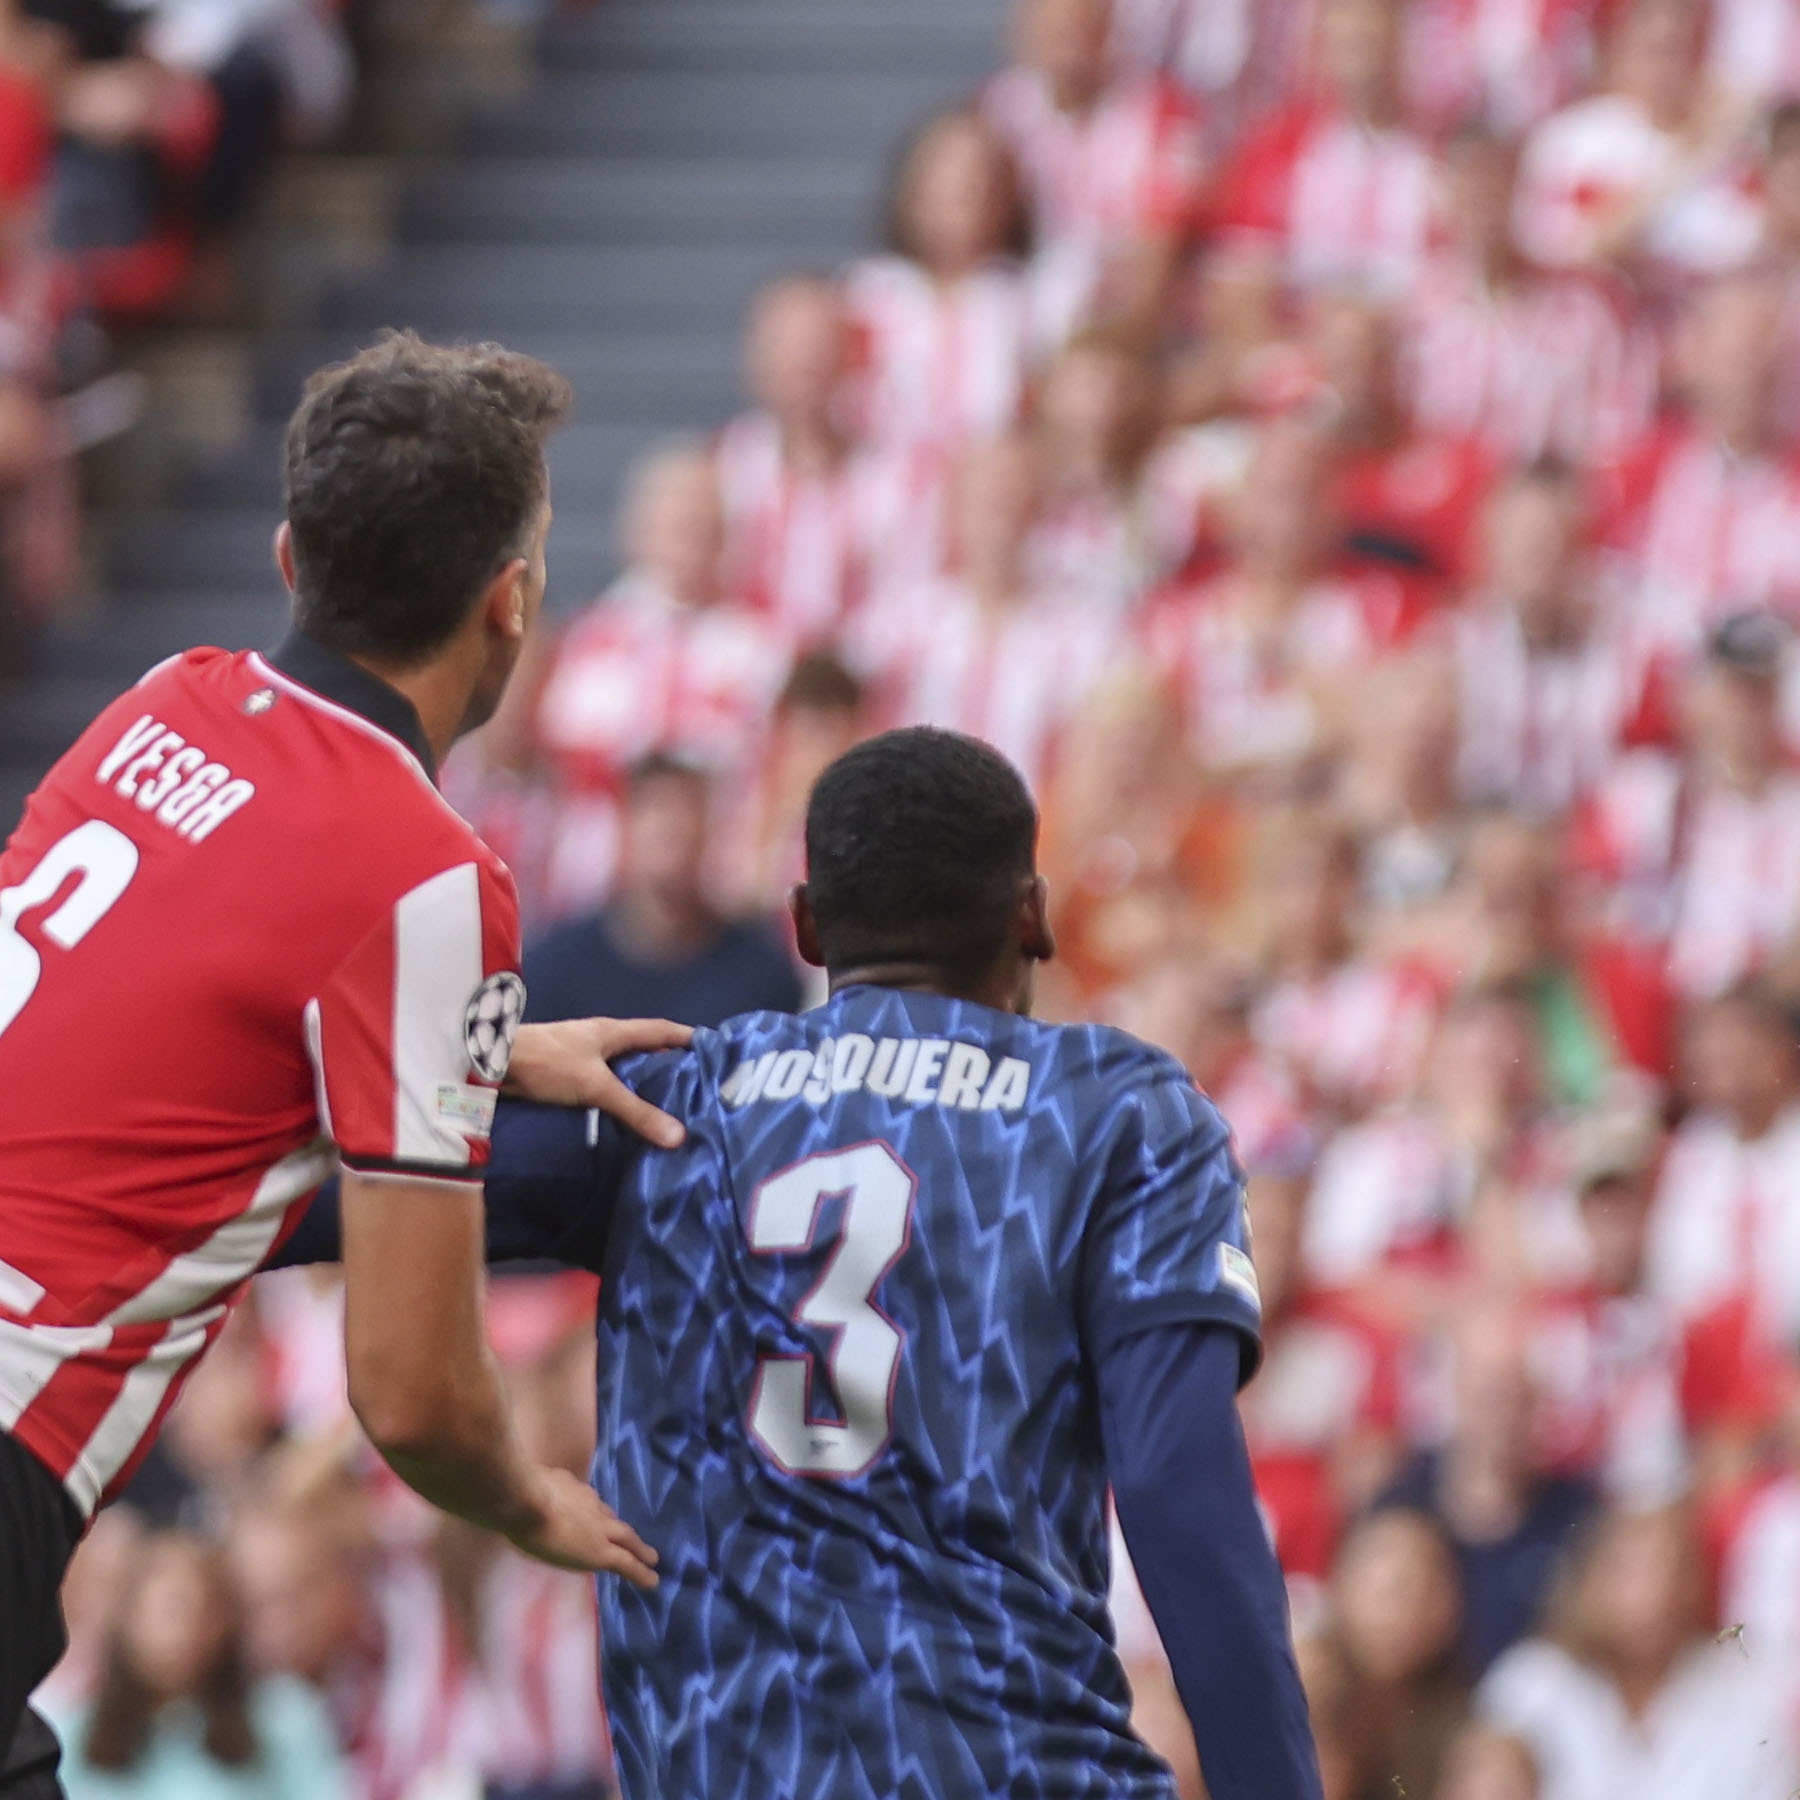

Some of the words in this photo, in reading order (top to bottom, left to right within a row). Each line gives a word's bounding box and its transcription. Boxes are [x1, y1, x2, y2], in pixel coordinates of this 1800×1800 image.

[95, 714, 256, 845] VESGA
[720, 1032, 1031, 1113] MOSQUERA
[748, 1138, 919, 1480] 3
